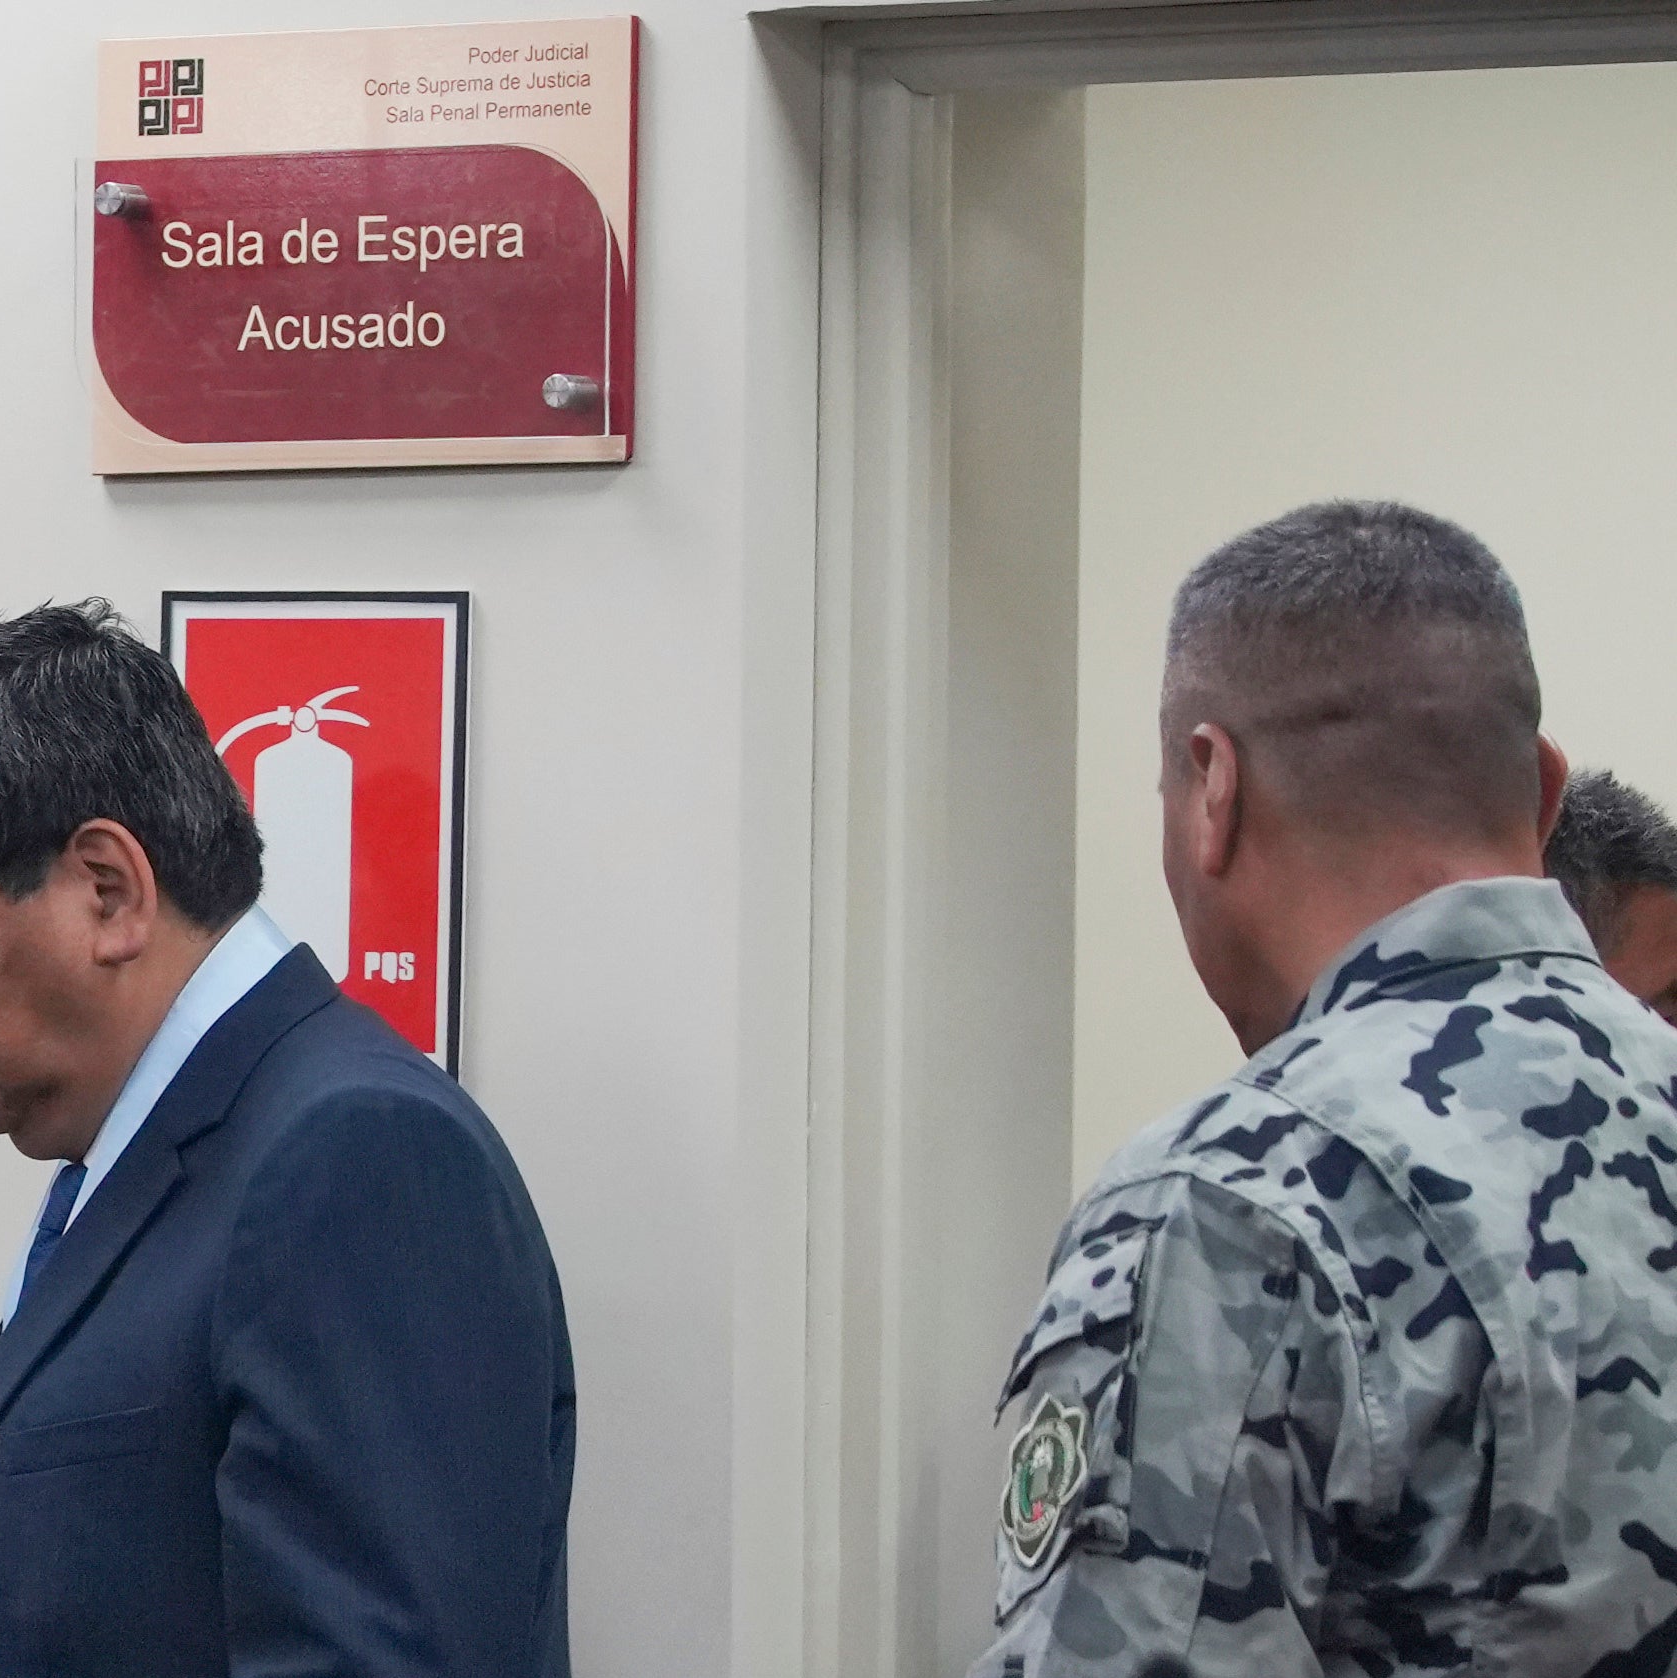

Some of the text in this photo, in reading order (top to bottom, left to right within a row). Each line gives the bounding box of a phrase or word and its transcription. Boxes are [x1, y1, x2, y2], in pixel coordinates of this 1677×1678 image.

[468, 42, 589, 65] Poder Judicial
[364, 71, 591, 98] Corte Suprema de Justicia
[385, 99, 592, 124] Sala Penal Permanente
[161, 214, 524, 273] Sala de Espera
[236, 300, 446, 352] Acusado
[364, 950, 415, 984] PQS
